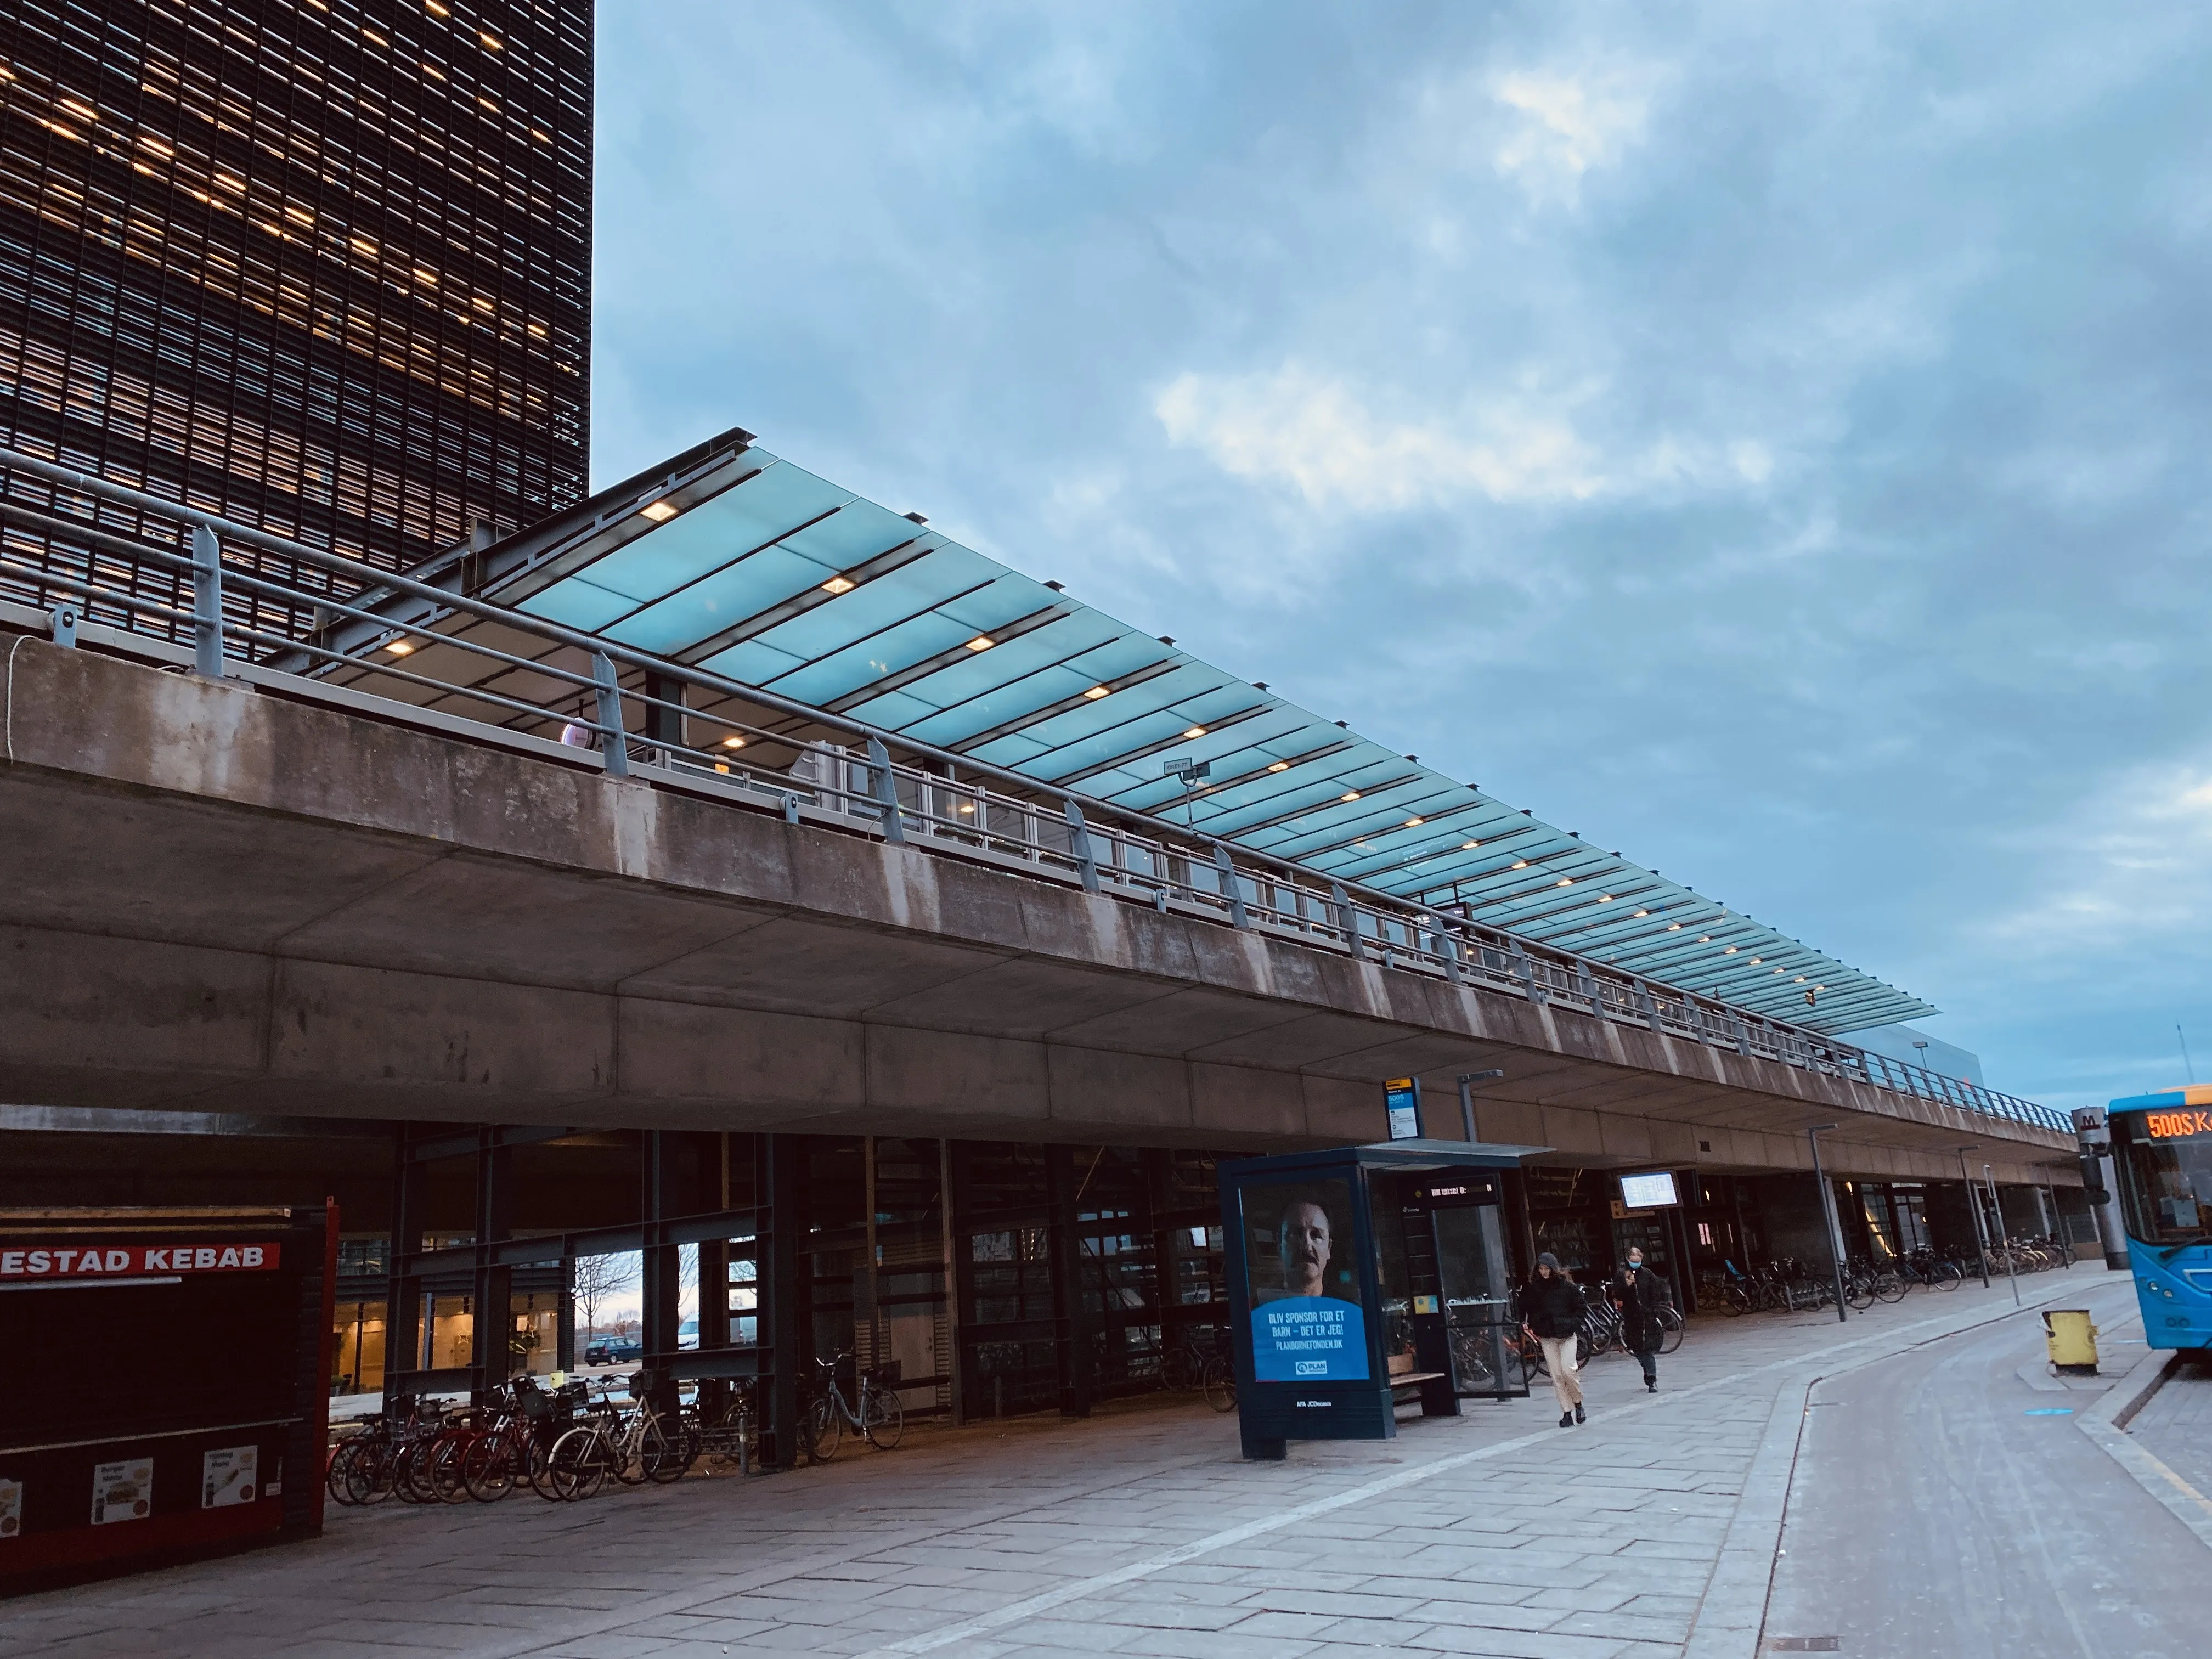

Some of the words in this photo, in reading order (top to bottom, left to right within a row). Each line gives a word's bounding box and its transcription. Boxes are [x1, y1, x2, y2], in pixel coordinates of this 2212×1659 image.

[2147, 1114, 2194, 1137] 500S
[2194, 1111, 2212, 1132] K
[145, 1247, 263, 1270] KEBAB
[1268, 1313, 1283, 1324] BLIV
[1285, 1311, 1318, 1323] SPONSOR
[1319, 1311, 1334, 1322] FOR
[1335, 1310, 1345, 1321] ET
[1272, 1326, 1291, 1338] BARN
[1300, 1325, 1314, 1336] DET
[1316, 1325, 1326, 1336] ER
[1328, 1324, 1343, 1335] JEG!
